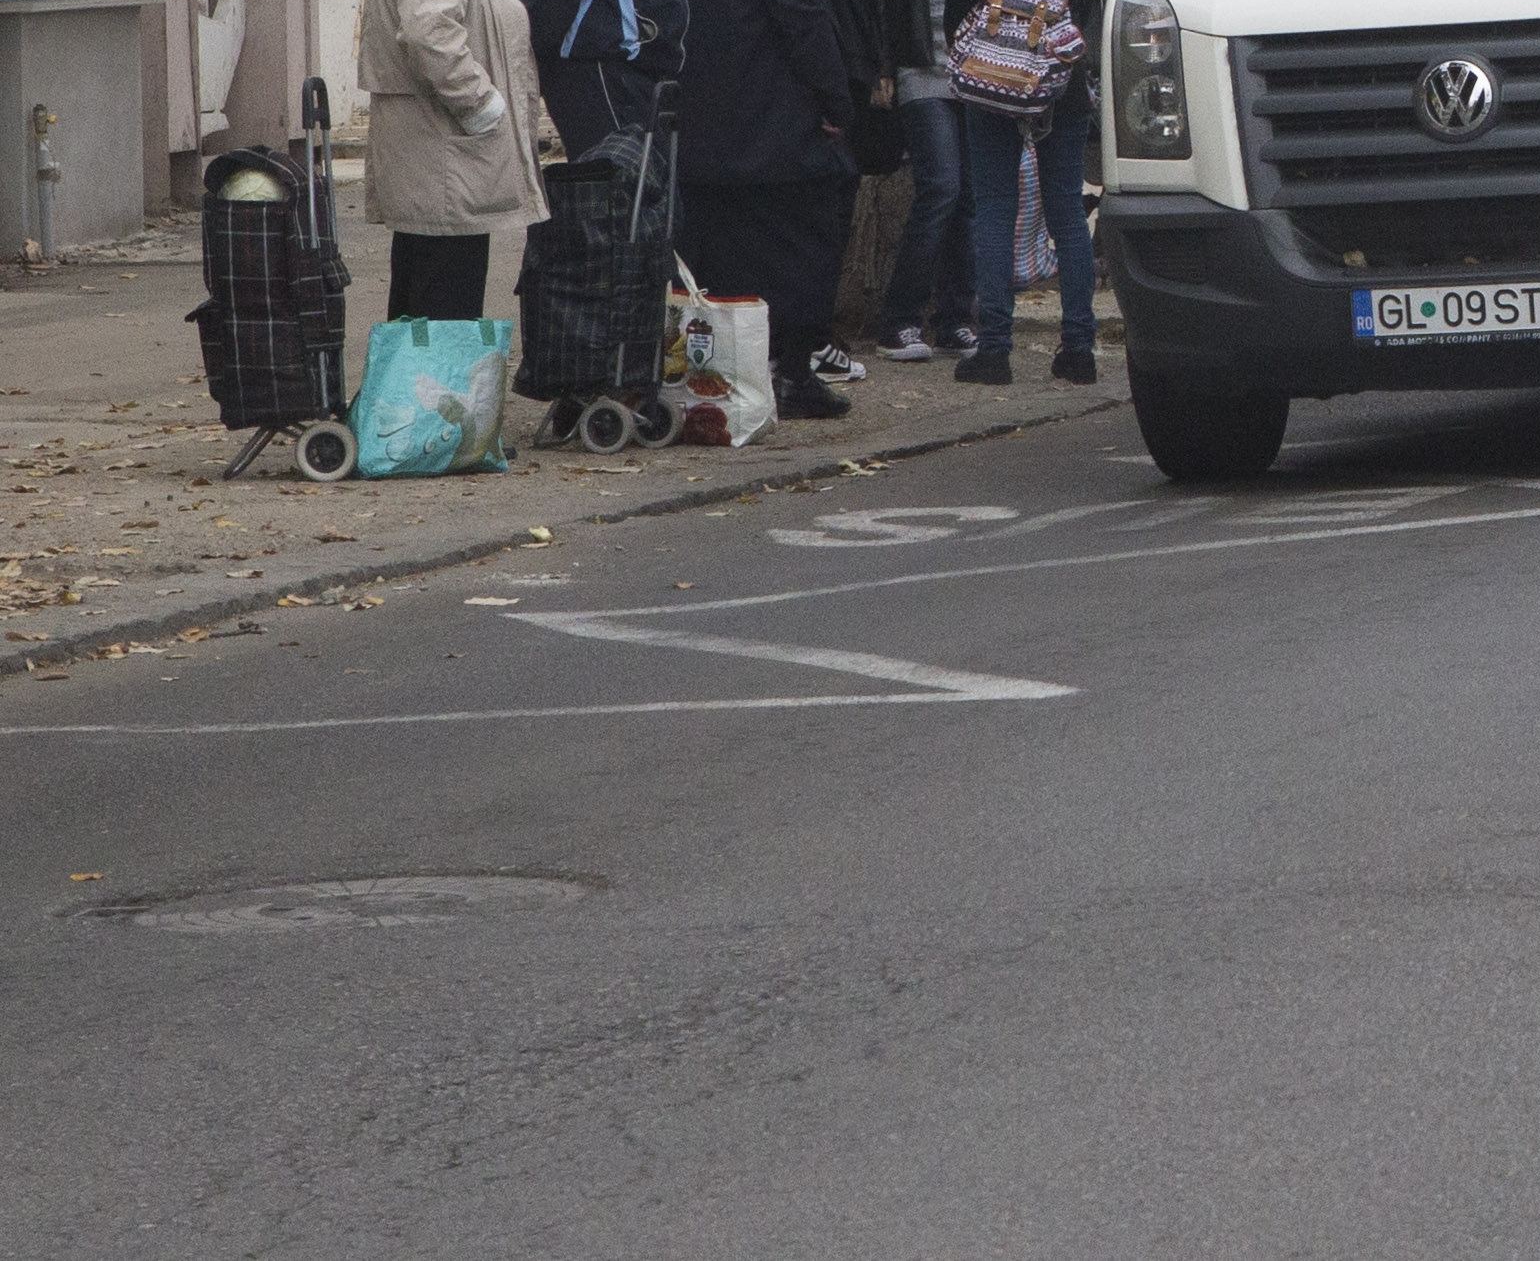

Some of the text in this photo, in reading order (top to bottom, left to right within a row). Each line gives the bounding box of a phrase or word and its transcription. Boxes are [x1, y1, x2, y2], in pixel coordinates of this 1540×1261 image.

[1356, 315, 1374, 330] RO
[1378, 293, 1427, 330] GL
[1442, 290, 1487, 328] 09
